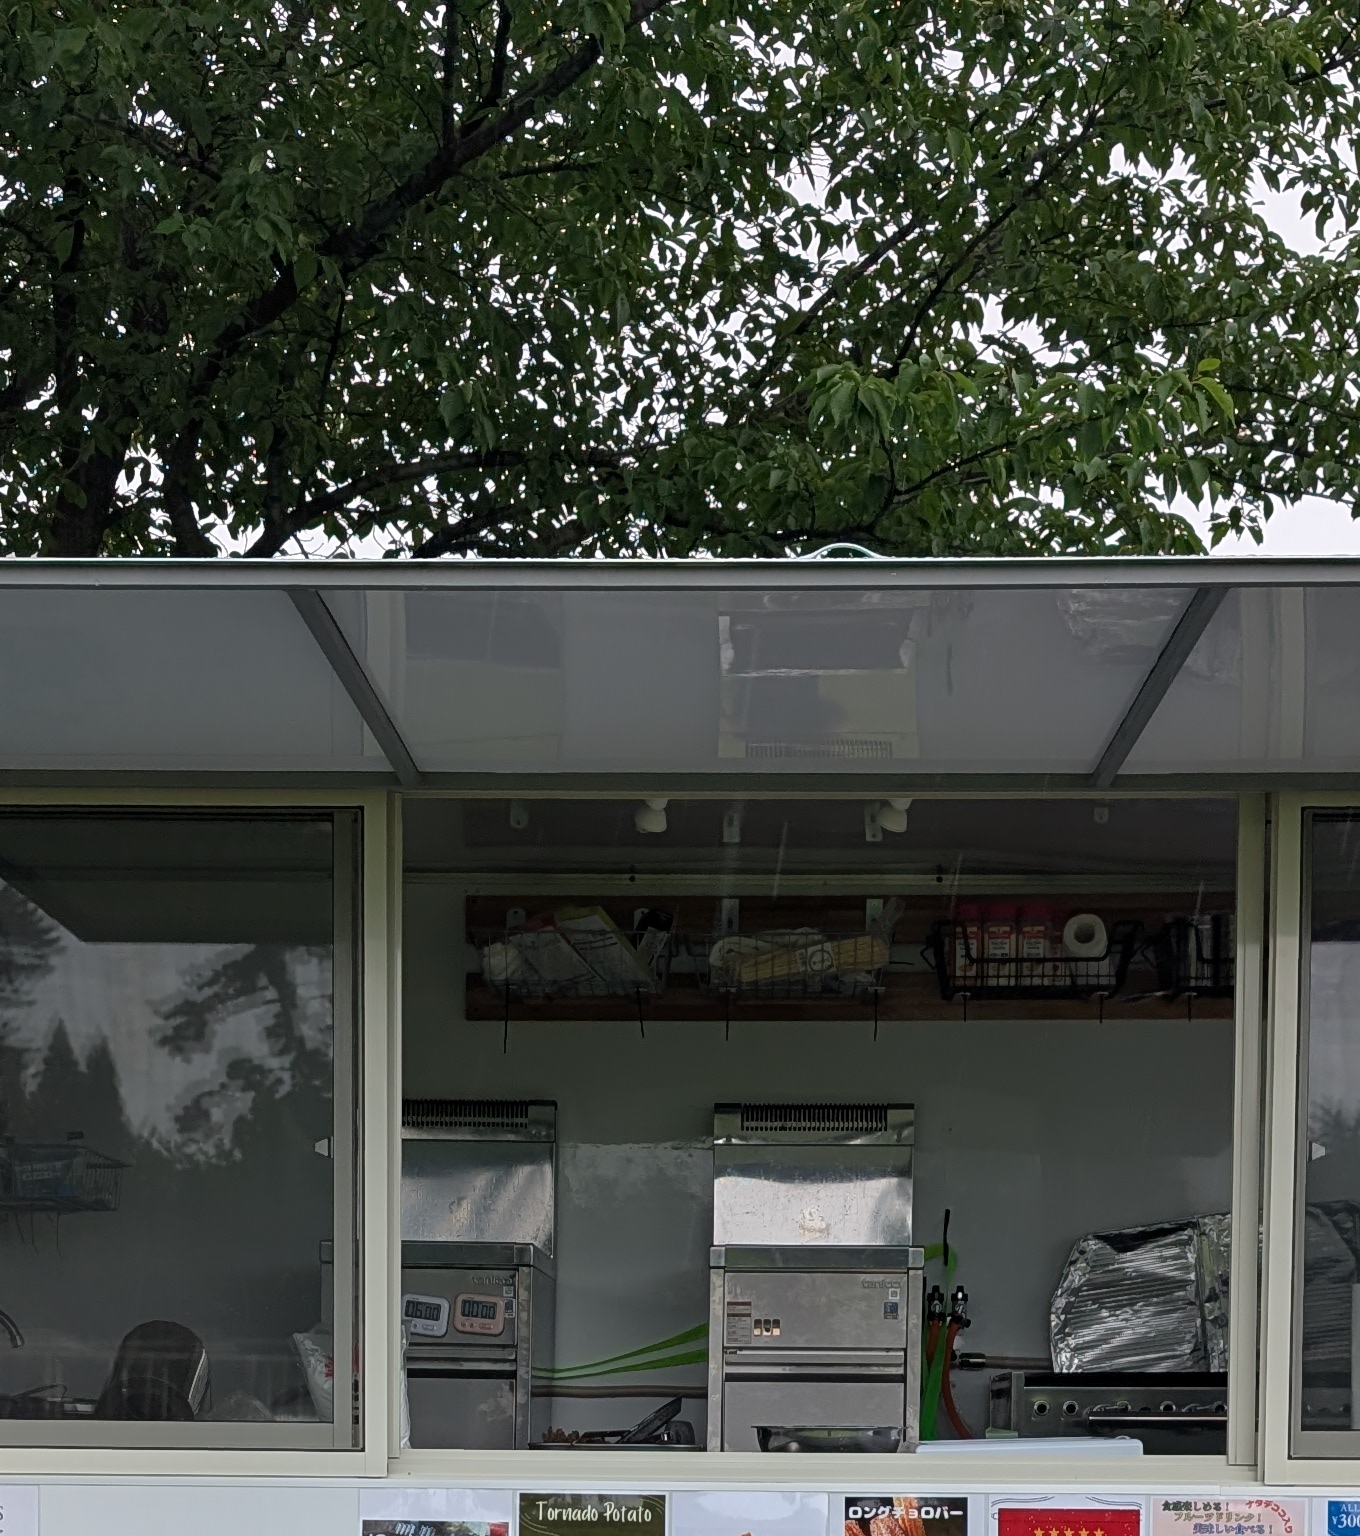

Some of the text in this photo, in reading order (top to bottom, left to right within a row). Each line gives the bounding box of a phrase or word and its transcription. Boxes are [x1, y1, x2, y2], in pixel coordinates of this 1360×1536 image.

[536, 1501, 652, 1523] Tornado Potato
[1340, 1503, 1360, 1513] ALL
